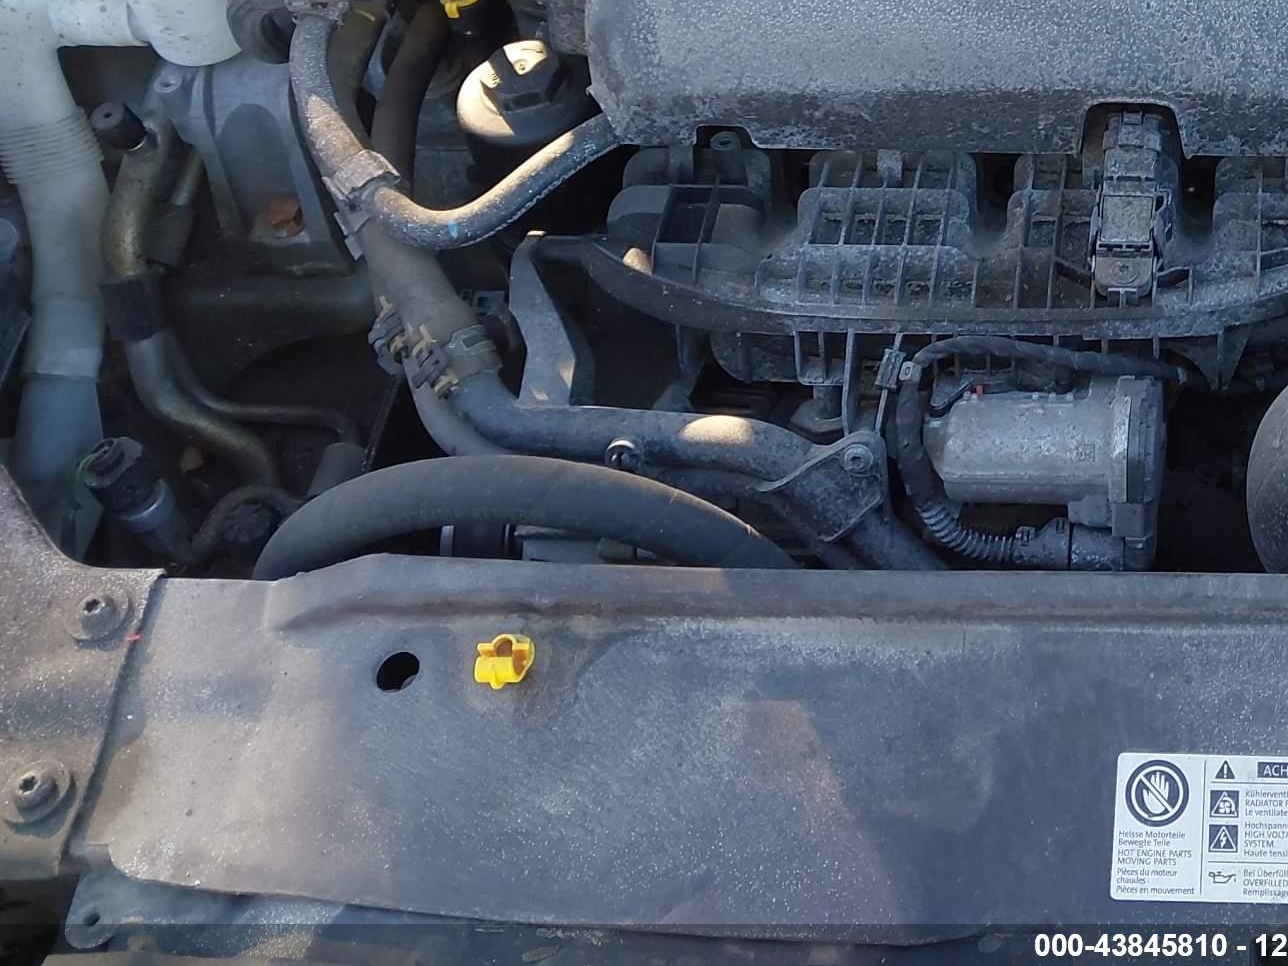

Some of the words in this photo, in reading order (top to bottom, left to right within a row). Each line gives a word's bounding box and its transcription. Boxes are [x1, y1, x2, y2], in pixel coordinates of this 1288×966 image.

[1246, 799, 1283, 807] RADIATOR
[1119, 830, 1143, 838] Heisse
[1145, 831, 1186, 839] Motorteile
[1244, 831, 1264, 839] HIGH
[1119, 838, 1151, 848] Bewegte
[1118, 849, 1135, 857] HOT
[1137, 849, 1167, 857] ENGINE
[1169, 850, 1192, 858] PARTS
[1244, 850, 1267, 858] Haute
[1154, 858, 1176, 866] PARTS
[1244, 869, 1255, 877] Bei
[1117, 876, 1146, 884] chaudes
[1243, 879, 1288, 887] OVERFILLED
